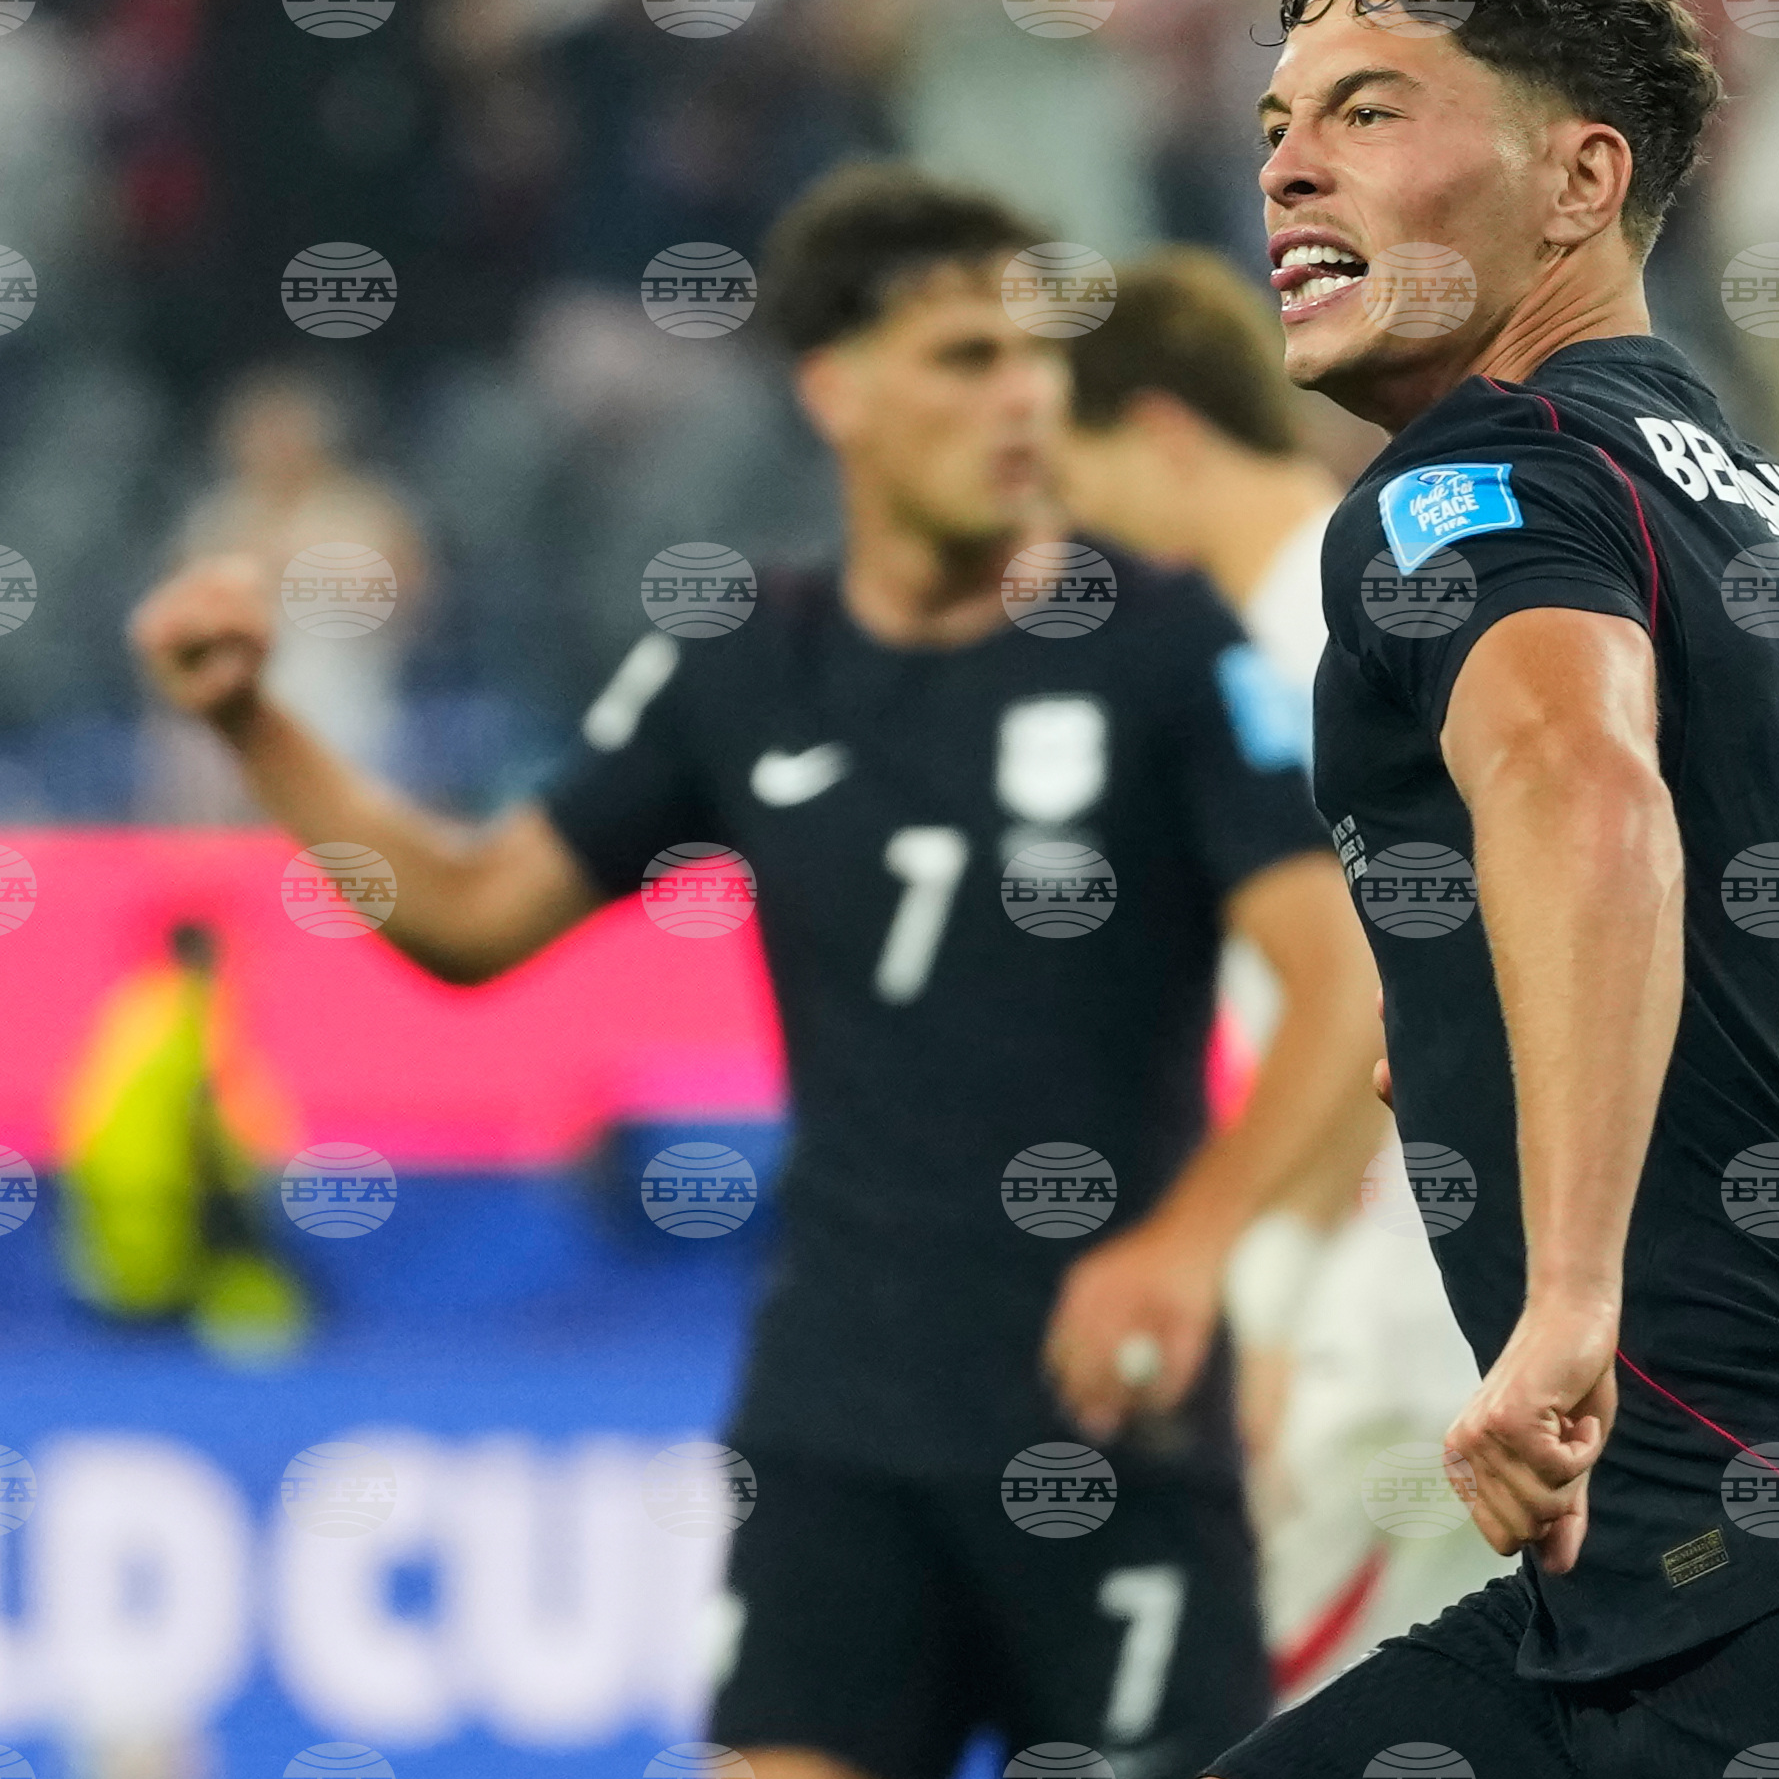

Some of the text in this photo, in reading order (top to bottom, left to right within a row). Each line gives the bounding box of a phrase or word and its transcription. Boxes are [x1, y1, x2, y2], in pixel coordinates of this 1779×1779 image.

[1417, 494, 1479, 532] PEACE
[1434, 516, 1470, 536] FIFA
[872, 823, 969, 1007] 7
[1098, 1563, 1188, 1742] 7
